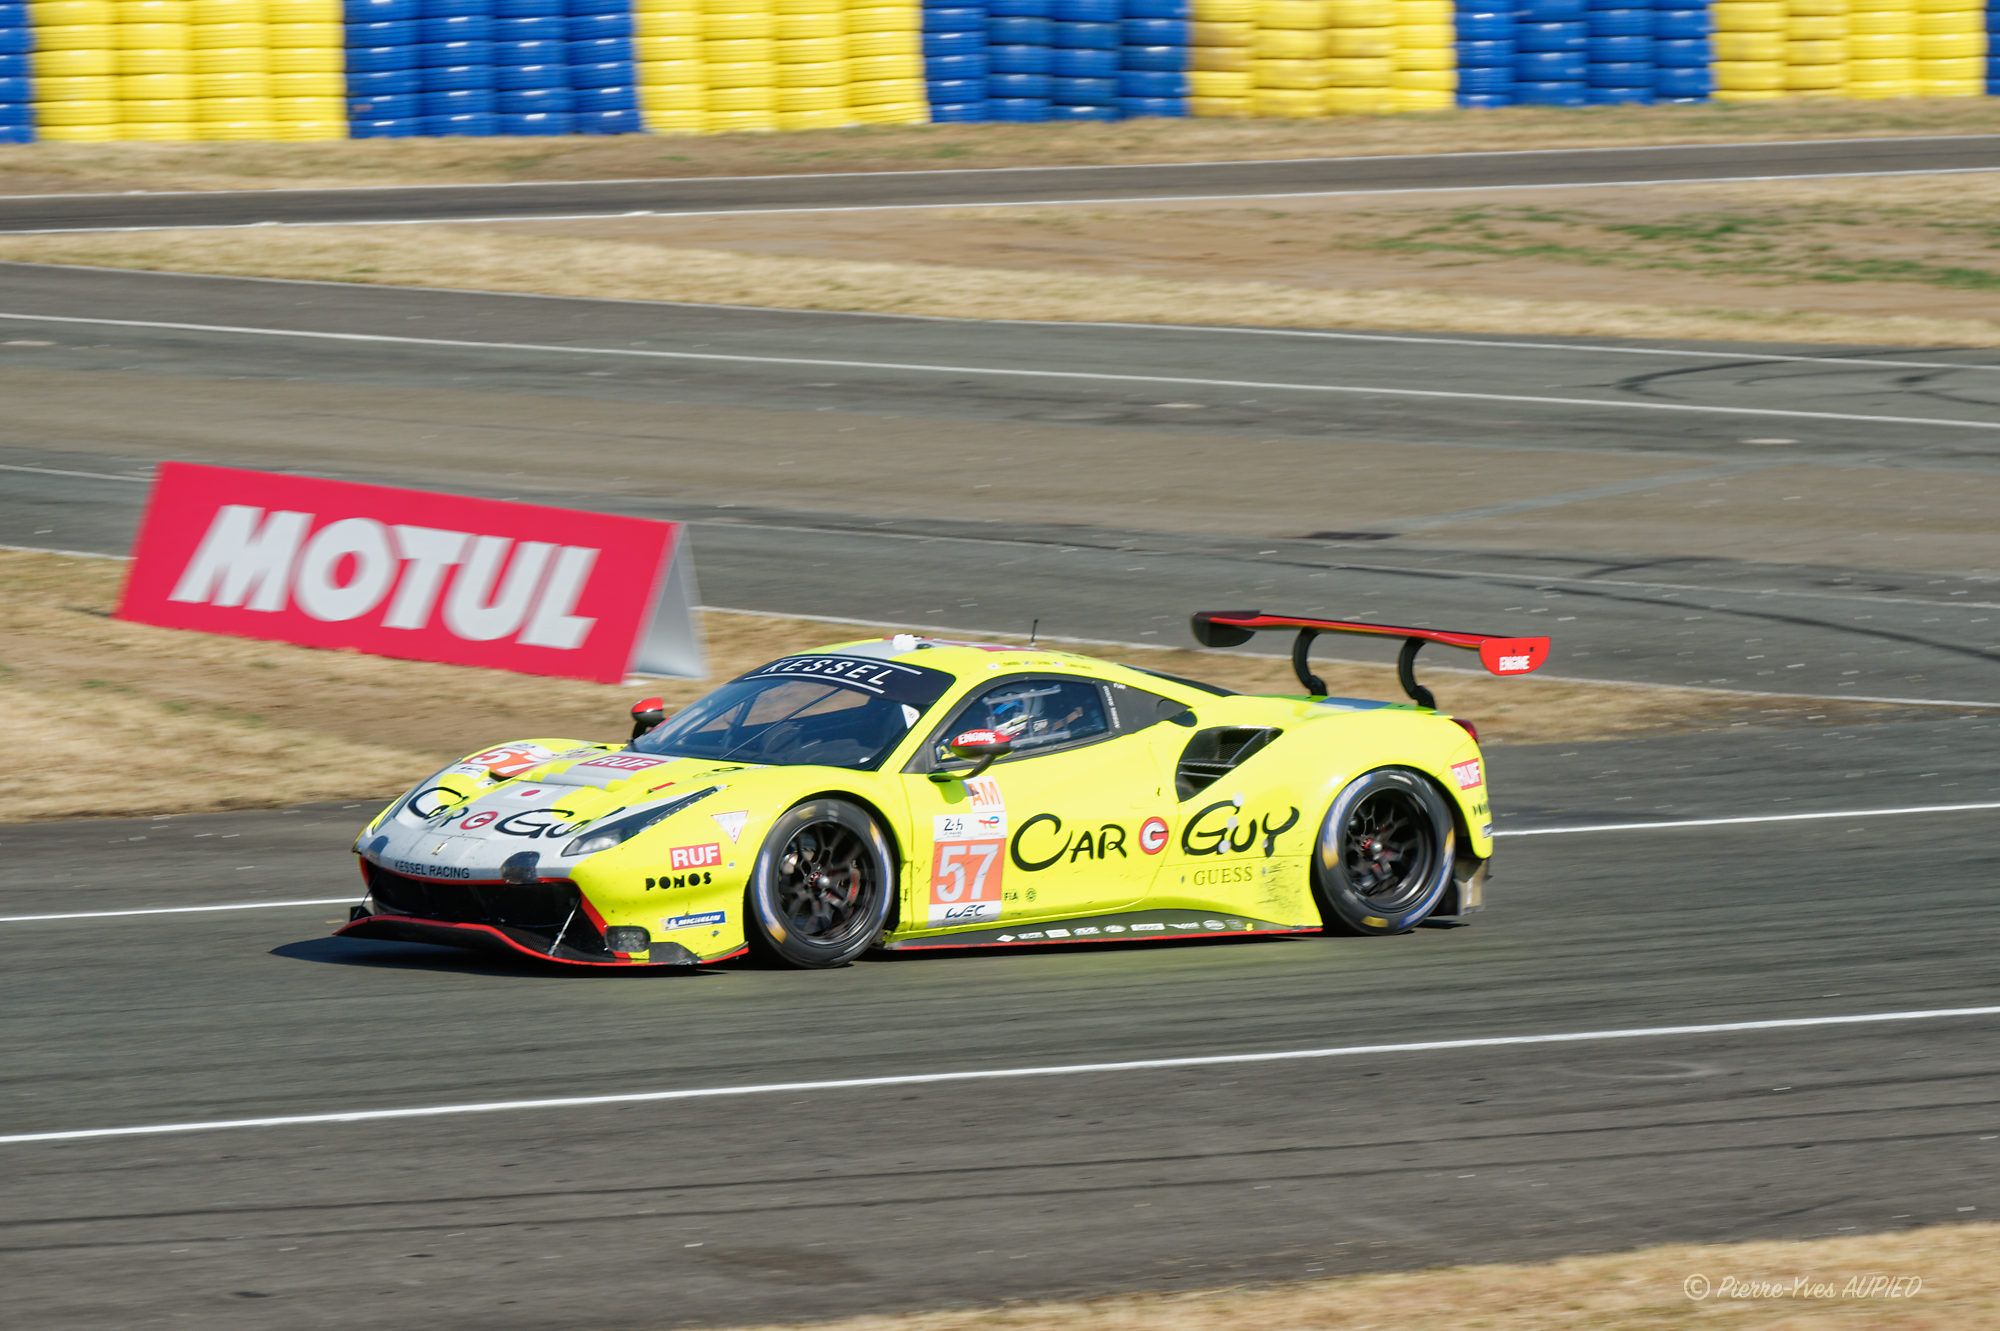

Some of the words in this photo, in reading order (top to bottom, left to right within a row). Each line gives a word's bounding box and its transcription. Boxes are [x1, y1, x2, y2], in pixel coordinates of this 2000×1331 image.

[167, 504, 601, 650] MOTUL
[762, 659, 893, 686] KESSEL
[958, 731, 996, 745] ENGINE
[589, 756, 659, 771] RUF
[1452, 761, 1480, 787] RUF
[968, 781, 1001, 806] AM
[672, 845, 719, 868] RUF
[394, 860, 427, 876] KESSEL
[429, 865, 470, 879] RACING
[936, 844, 999, 903] 57
[1193, 866, 1253, 886] GUESS
[645, 872, 712, 891] PONOS
[677, 913, 721, 927] MICHELIN
[945, 904, 986, 918] WEC
